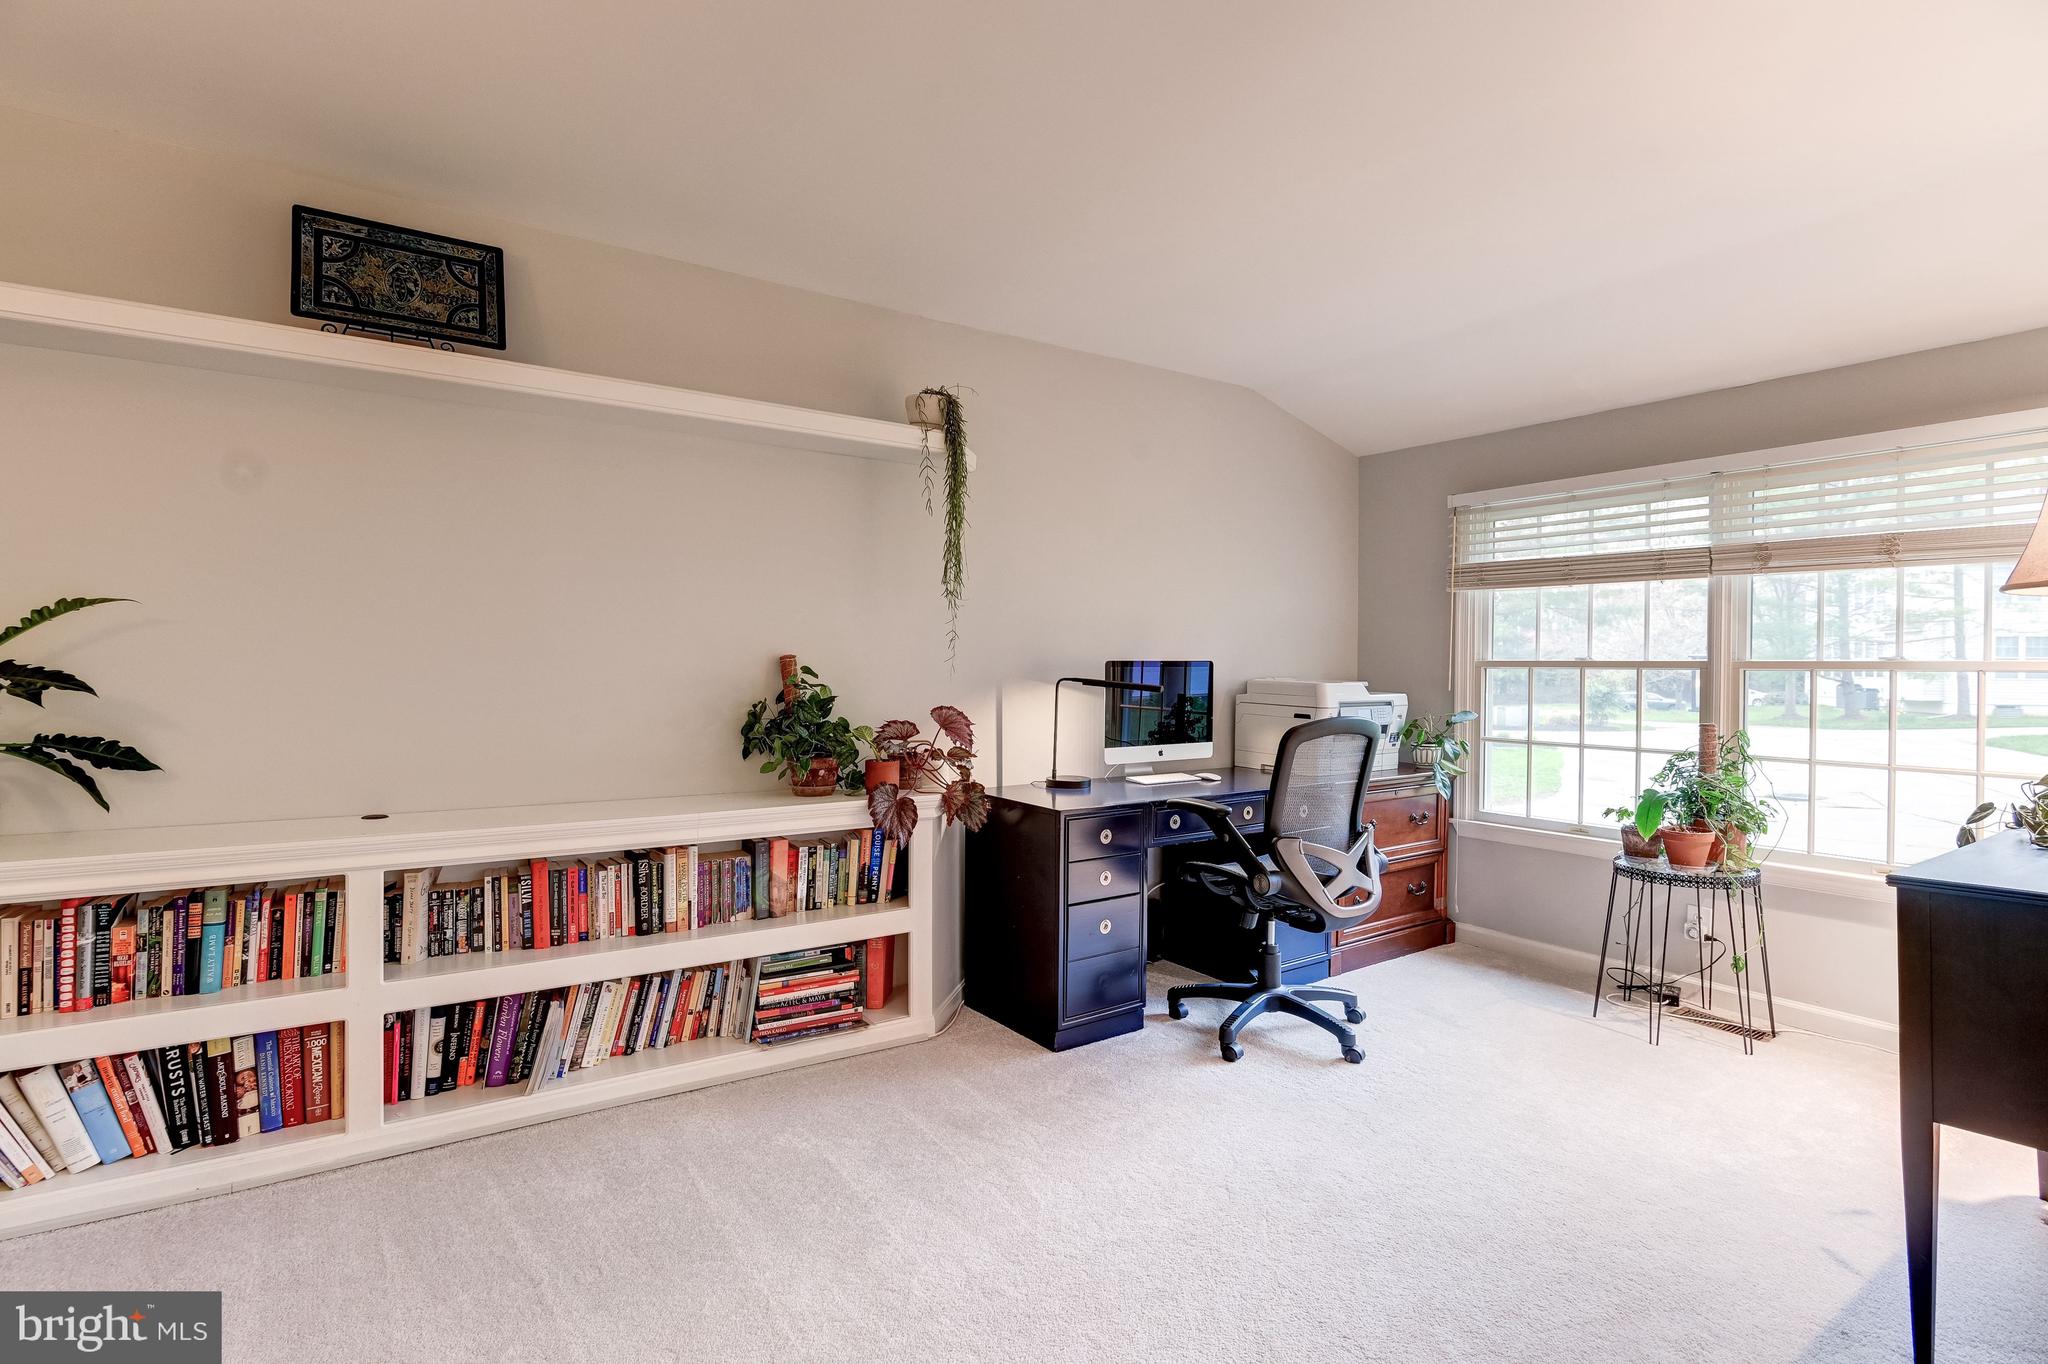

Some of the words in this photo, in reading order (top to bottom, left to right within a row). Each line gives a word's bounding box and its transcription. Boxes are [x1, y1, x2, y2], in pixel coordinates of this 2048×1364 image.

[874, 830, 882, 857] LOUISE
[638, 862, 649, 885] Silva
[872, 867, 880, 891] PENNY
[521, 880, 532, 905] SILVA
[640, 890, 649, 920] ORDER
[22, 924, 32, 945] Portrait
[208, 934, 218, 957] LAMB
[207, 957, 217, 985] WALLY
[640, 981, 650, 999] LANGUAGE
[499, 996, 513, 1027] Garden
[779, 998, 801, 1008] AZTEC
[808, 994, 826, 1003] MAYA
[531, 1029, 540, 1043] Every
[772, 1027, 788, 1035] KAHLO
[291, 1036, 300, 1052] THE
[305, 1038, 328, 1049] 1000
[448, 1032, 461, 1061] INFERNO
[493, 1029, 507, 1063] Flowers
[525, 1043, 536, 1062] Purpose
[217, 1062, 225, 1072] ART
[283, 1039, 292, 1075] MEXICAN
[292, 1052, 302, 1068] ART
[311, 1046, 323, 1083] MEXICAN
[166, 1046, 186, 1098] RUSTS
[196, 1058, 204, 1079] FLOUR
[293, 1068, 302, 1080] OF
[119, 1071, 131, 1088] OLIVER
[199, 1079, 207, 1099] WATER
[218, 1077, 226, 1092] SOUL
[284, 1074, 295, 1111] COOKING
[312, 1083, 324, 1105] Recipes
[180, 1105, 188, 1125] Ultimate
[220, 1095, 229, 1118] BAKING
[203, 1112, 211, 1132] YEAST
